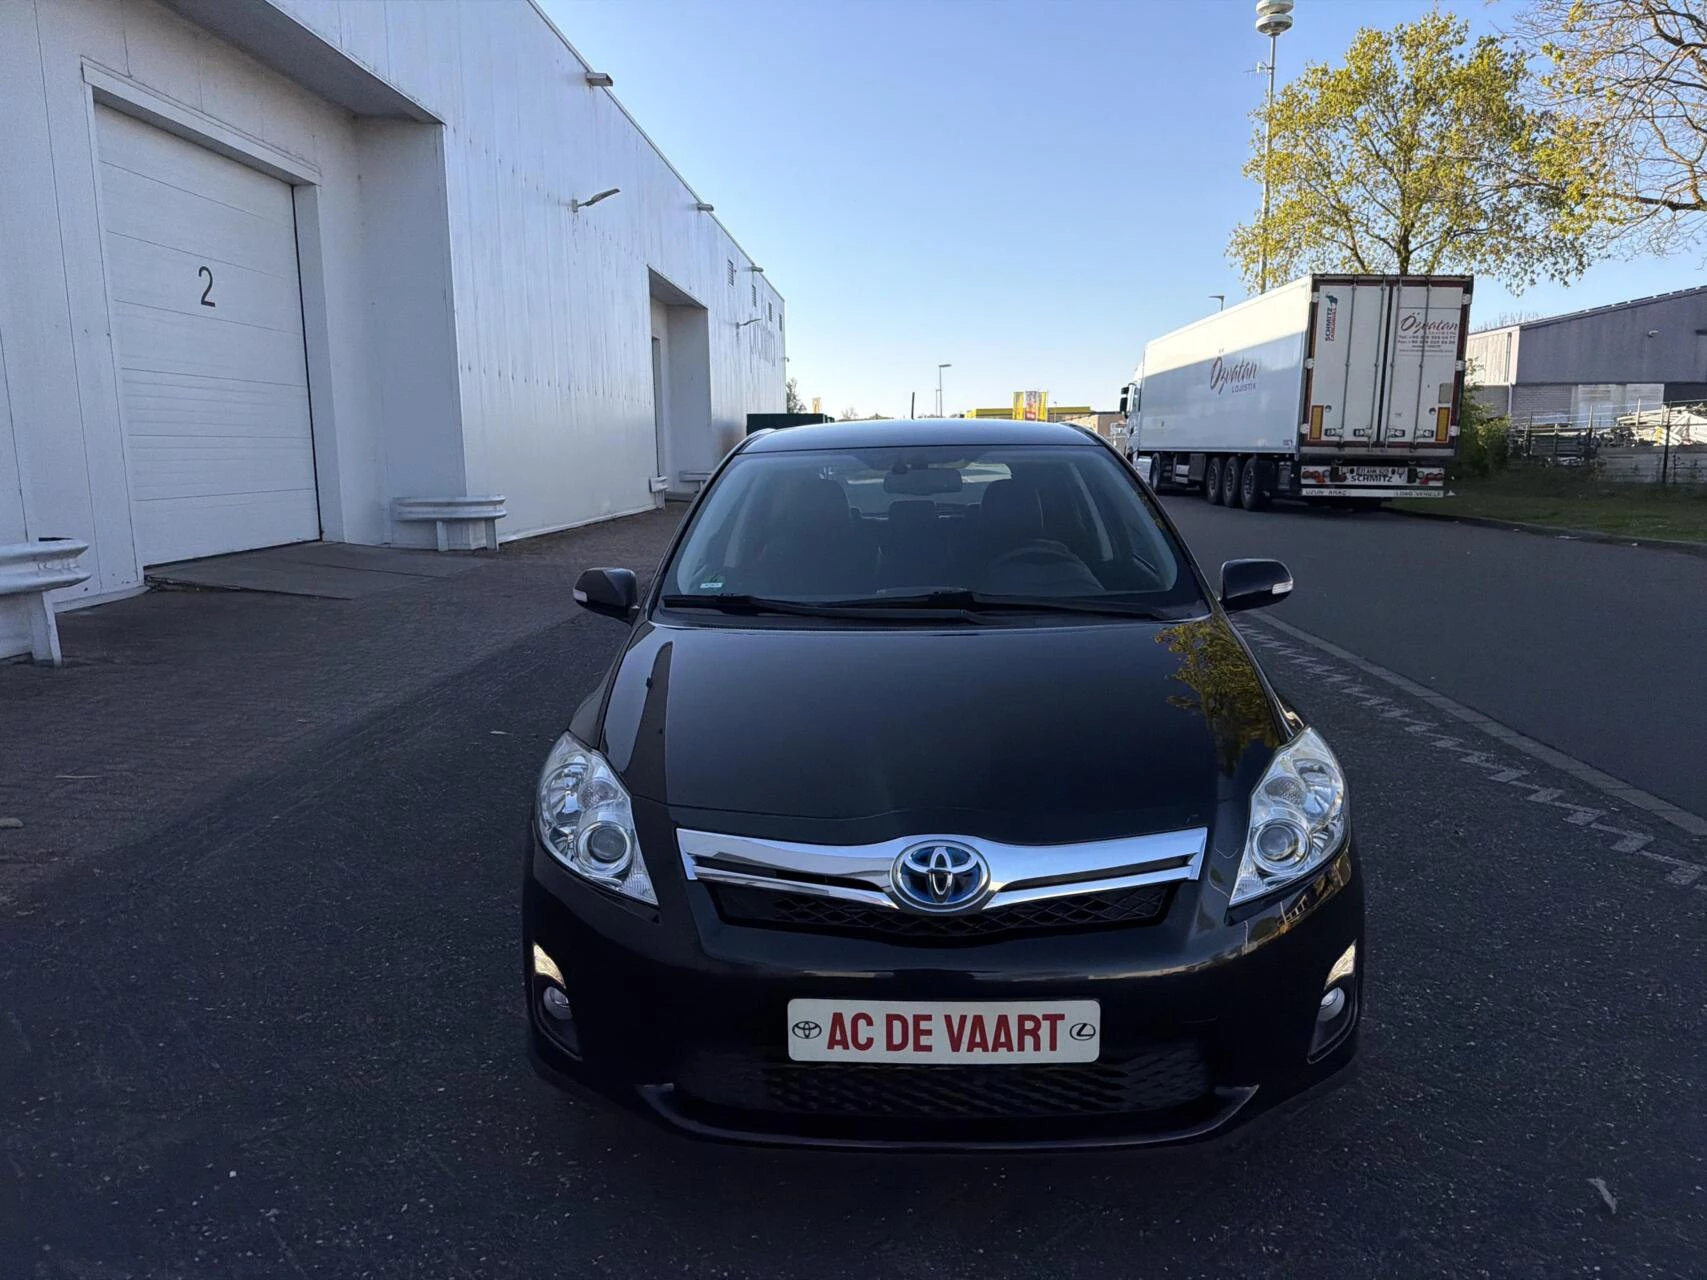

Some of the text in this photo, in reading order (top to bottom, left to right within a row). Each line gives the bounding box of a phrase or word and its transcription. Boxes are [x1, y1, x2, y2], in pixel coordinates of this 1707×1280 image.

[199, 266, 216, 307] 2
[826, 1012, 1065, 1053] AC DE VAART
